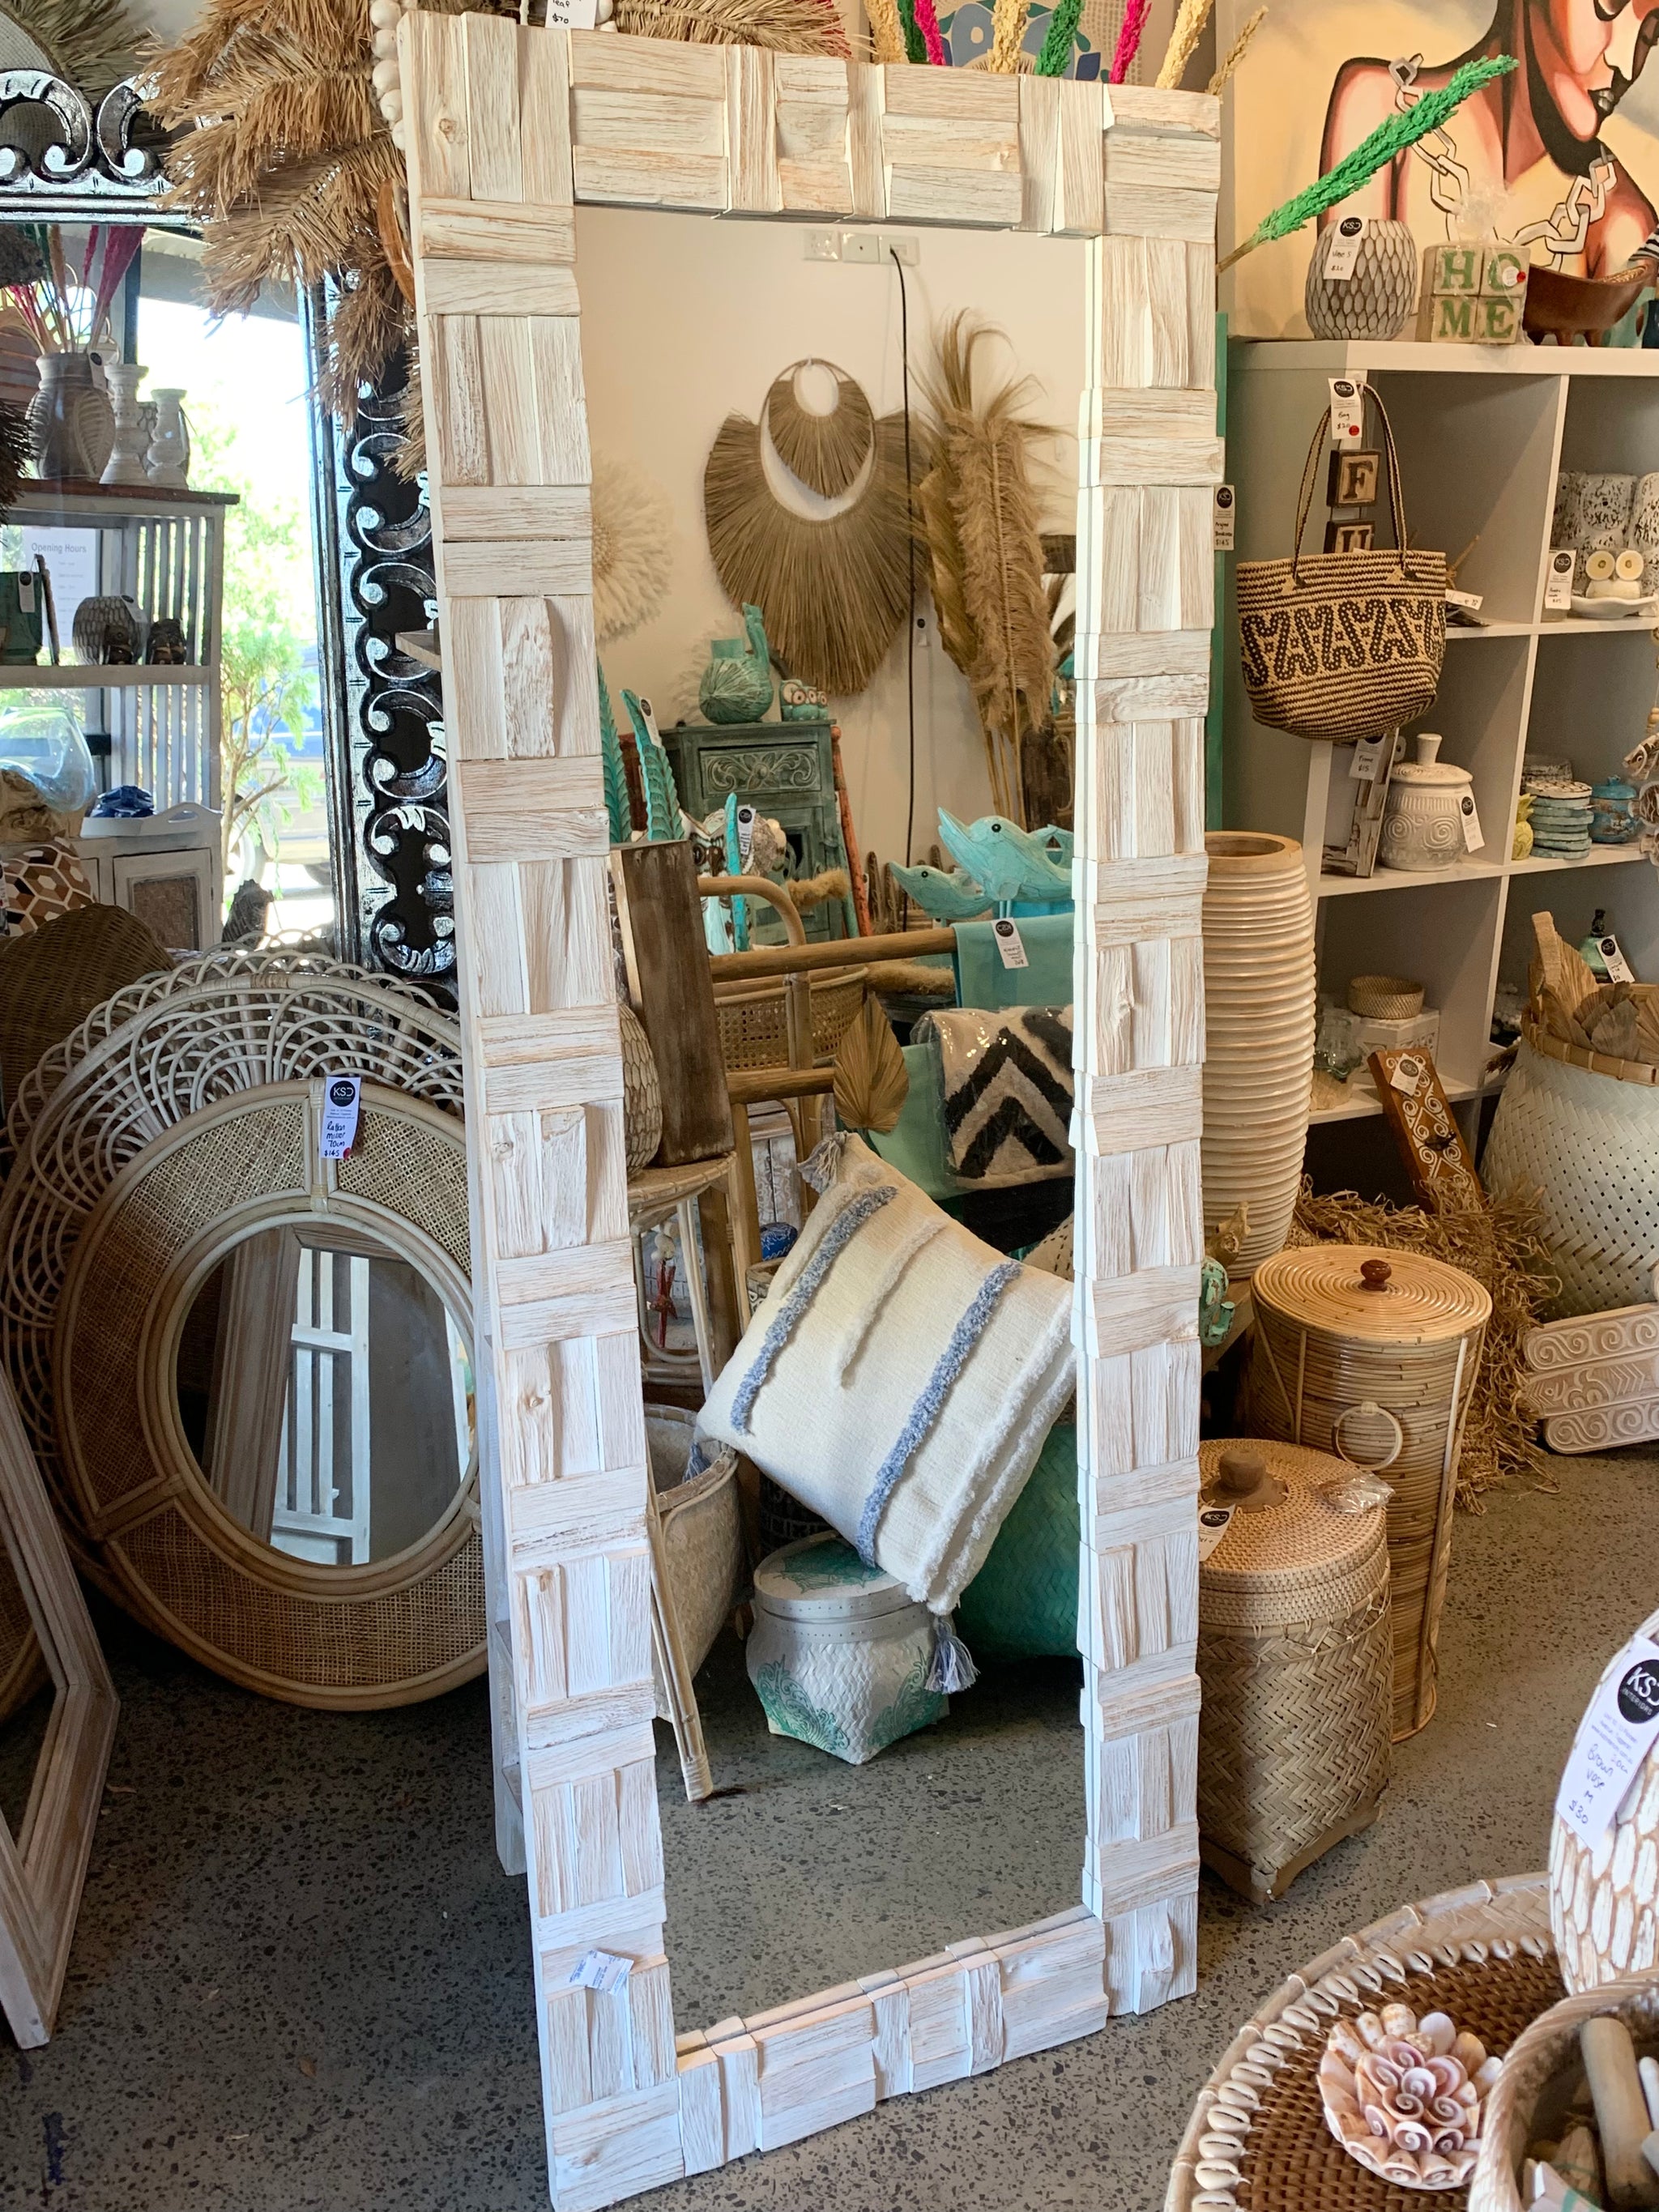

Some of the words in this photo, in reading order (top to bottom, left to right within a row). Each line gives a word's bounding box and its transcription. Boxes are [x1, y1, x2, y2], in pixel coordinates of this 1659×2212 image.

[552, 13, 569, 24] $70
[1439, 298, 1514, 339] ME
[1343, 460, 1374, 500] F
[32, 543, 63, 554] Opening
[65, 544, 87, 552] Hours
[333, 1087, 354, 1097] KSD
[326, 1120, 346, 1132] Rattan
[327, 1140, 345, 1148] 70cm
[324, 1149, 340, 1157] $145
[1621, 1687, 1653, 1716] INTERIORS
[1588, 1743, 1614, 1777] Brown
[1568, 1799, 1589, 1824] $30
